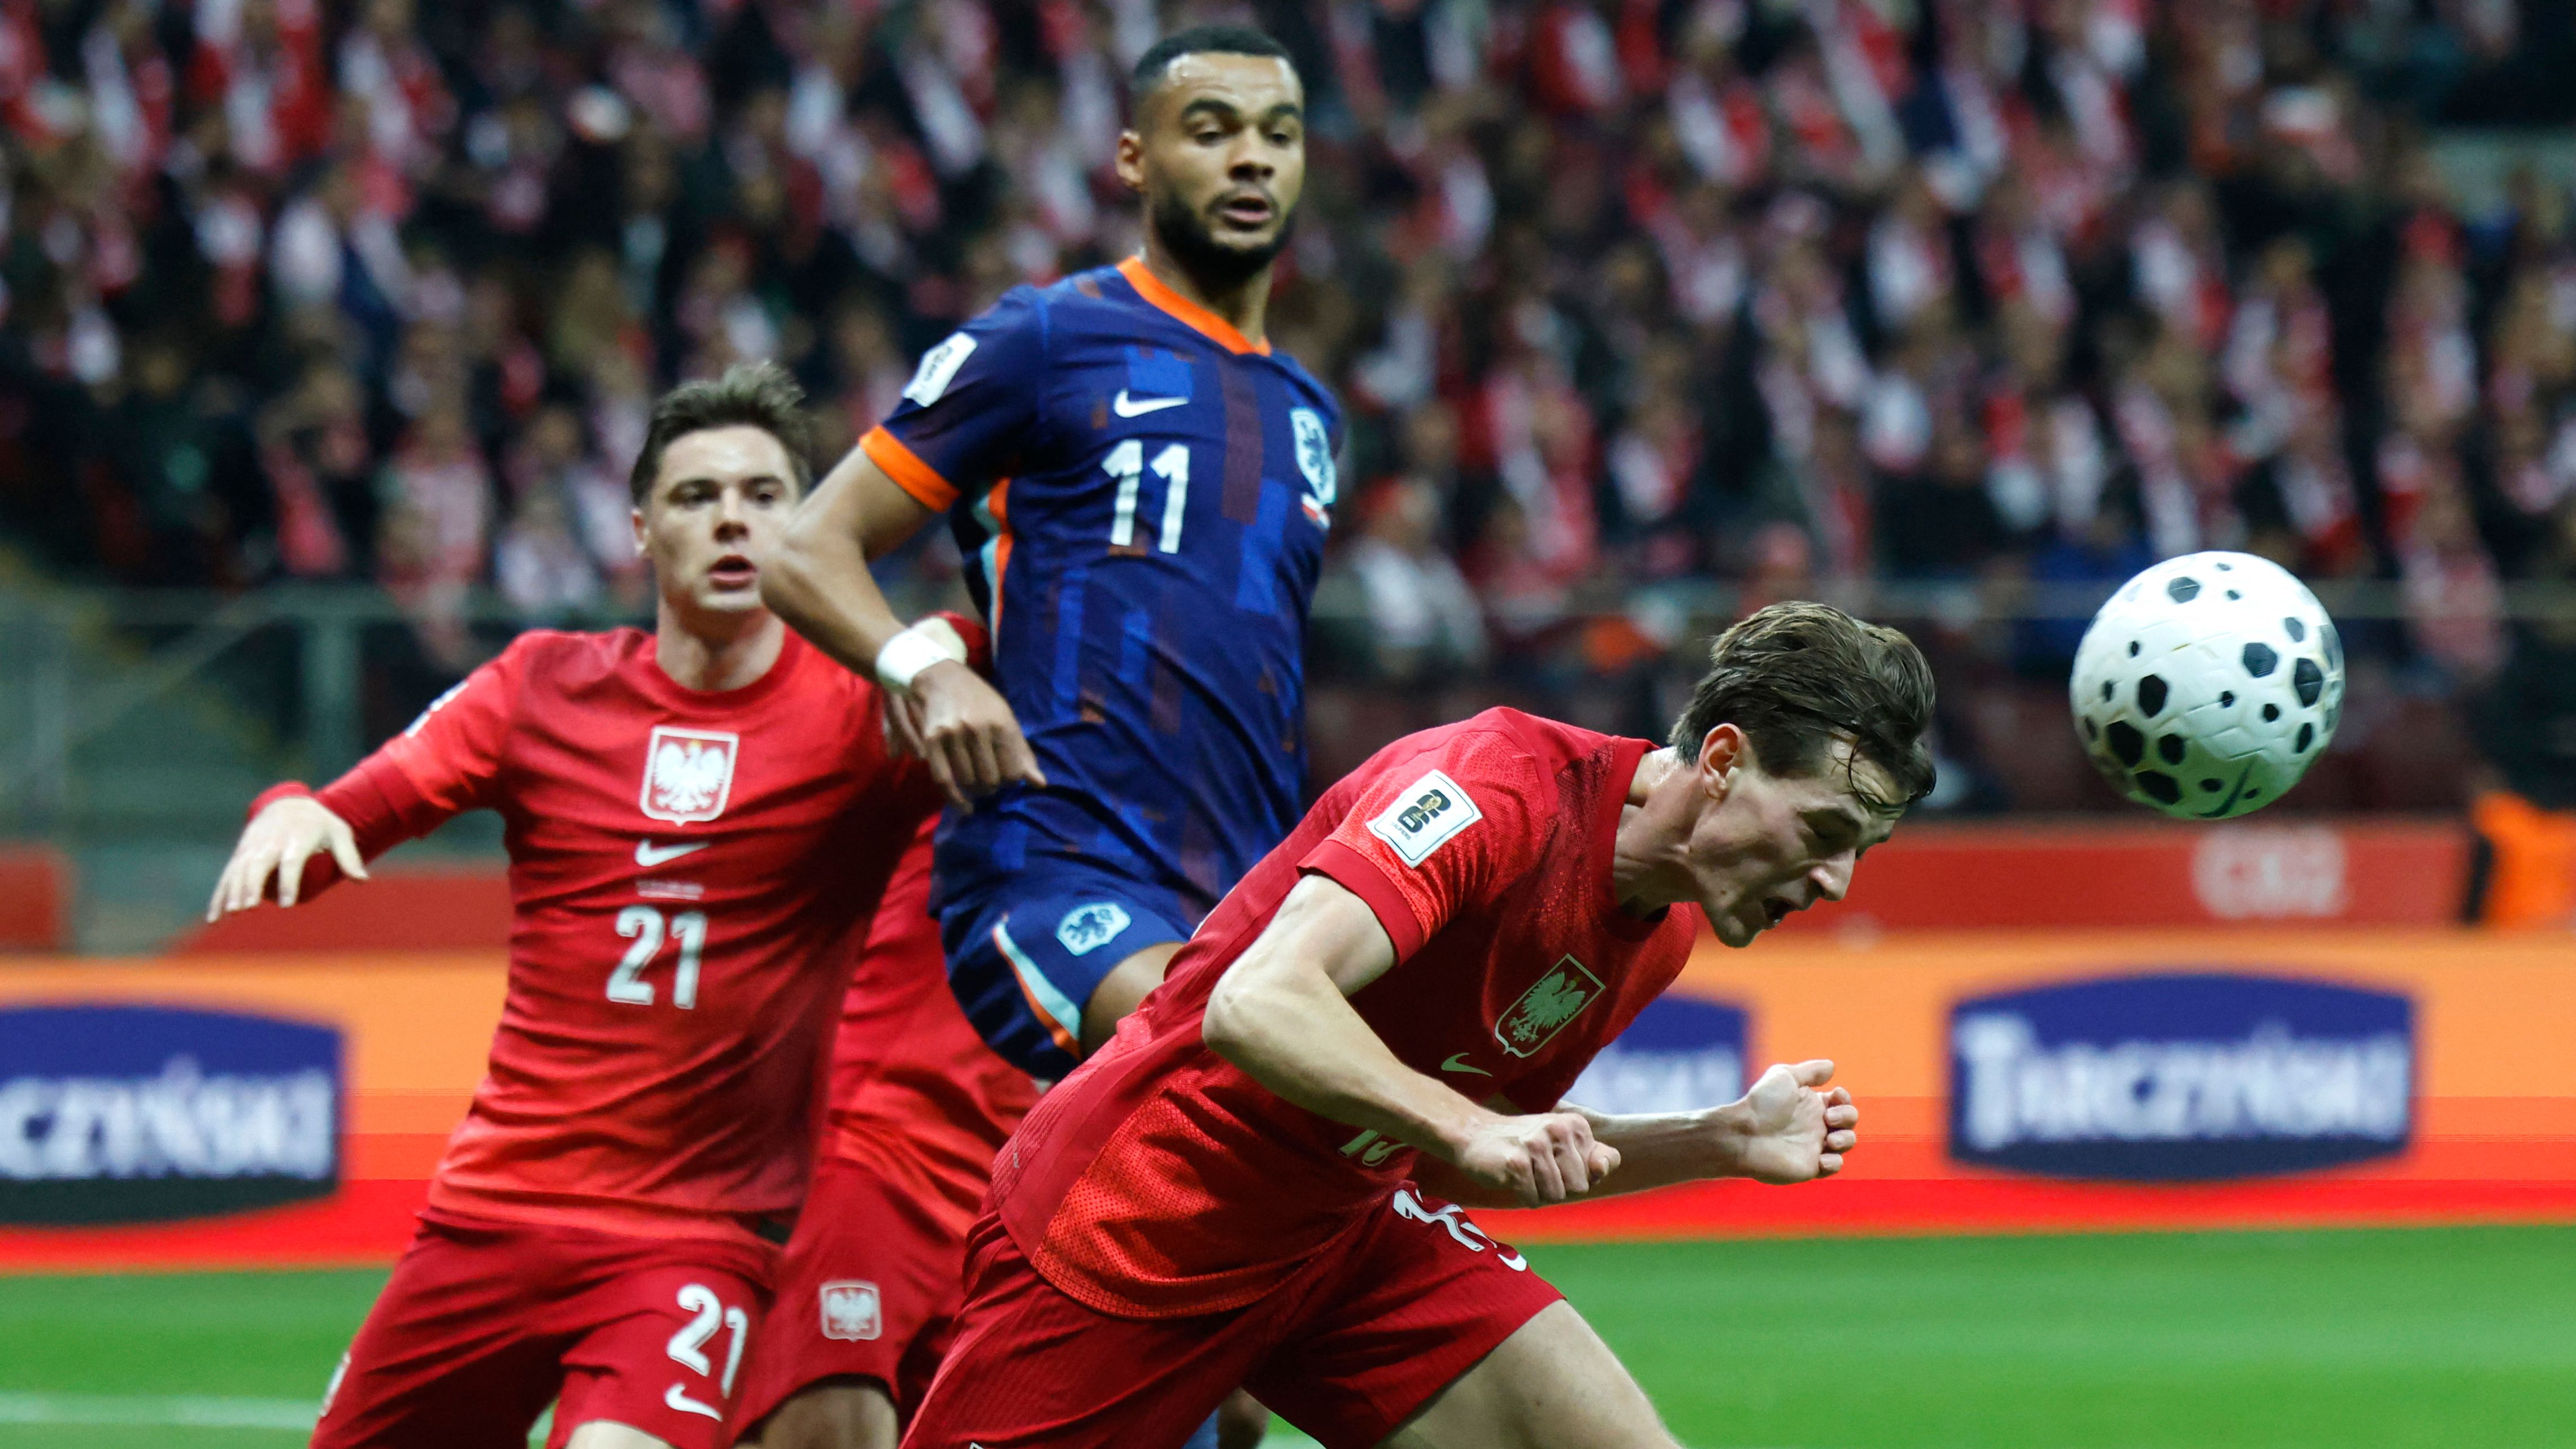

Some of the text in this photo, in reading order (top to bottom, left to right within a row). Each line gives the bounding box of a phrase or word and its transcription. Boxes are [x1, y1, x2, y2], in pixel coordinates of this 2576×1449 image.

[1101, 440, 1190, 554] 11
[605, 904, 708, 1009] 21
[667, 1283, 749, 1399] 21
